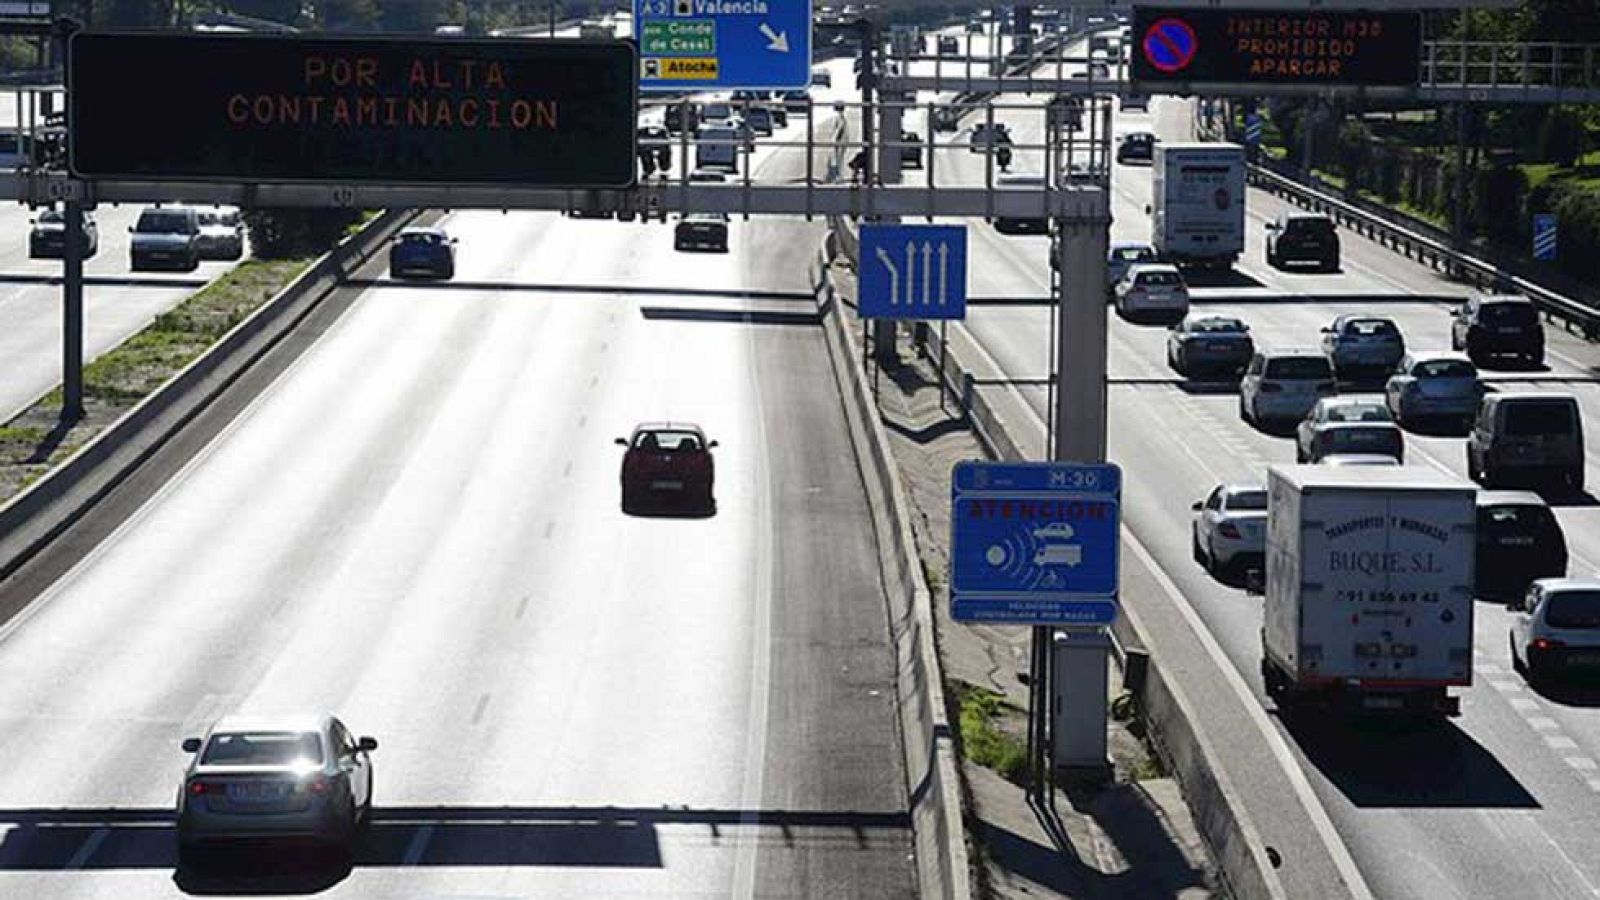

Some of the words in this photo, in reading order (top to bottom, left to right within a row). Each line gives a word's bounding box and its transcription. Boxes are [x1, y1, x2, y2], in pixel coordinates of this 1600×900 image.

[695, 0, 767, 14] Valencia
[1227, 17, 1330, 36] INTERIOR
[1238, 38, 1356, 56] PROHIBIDO
[304, 56, 380, 87] POR
[408, 58, 506, 89] ALTA
[668, 61, 717, 73] Atocha
[1250, 58, 1342, 76] APARCAR
[227, 93, 558, 129] CONTAMINACION
